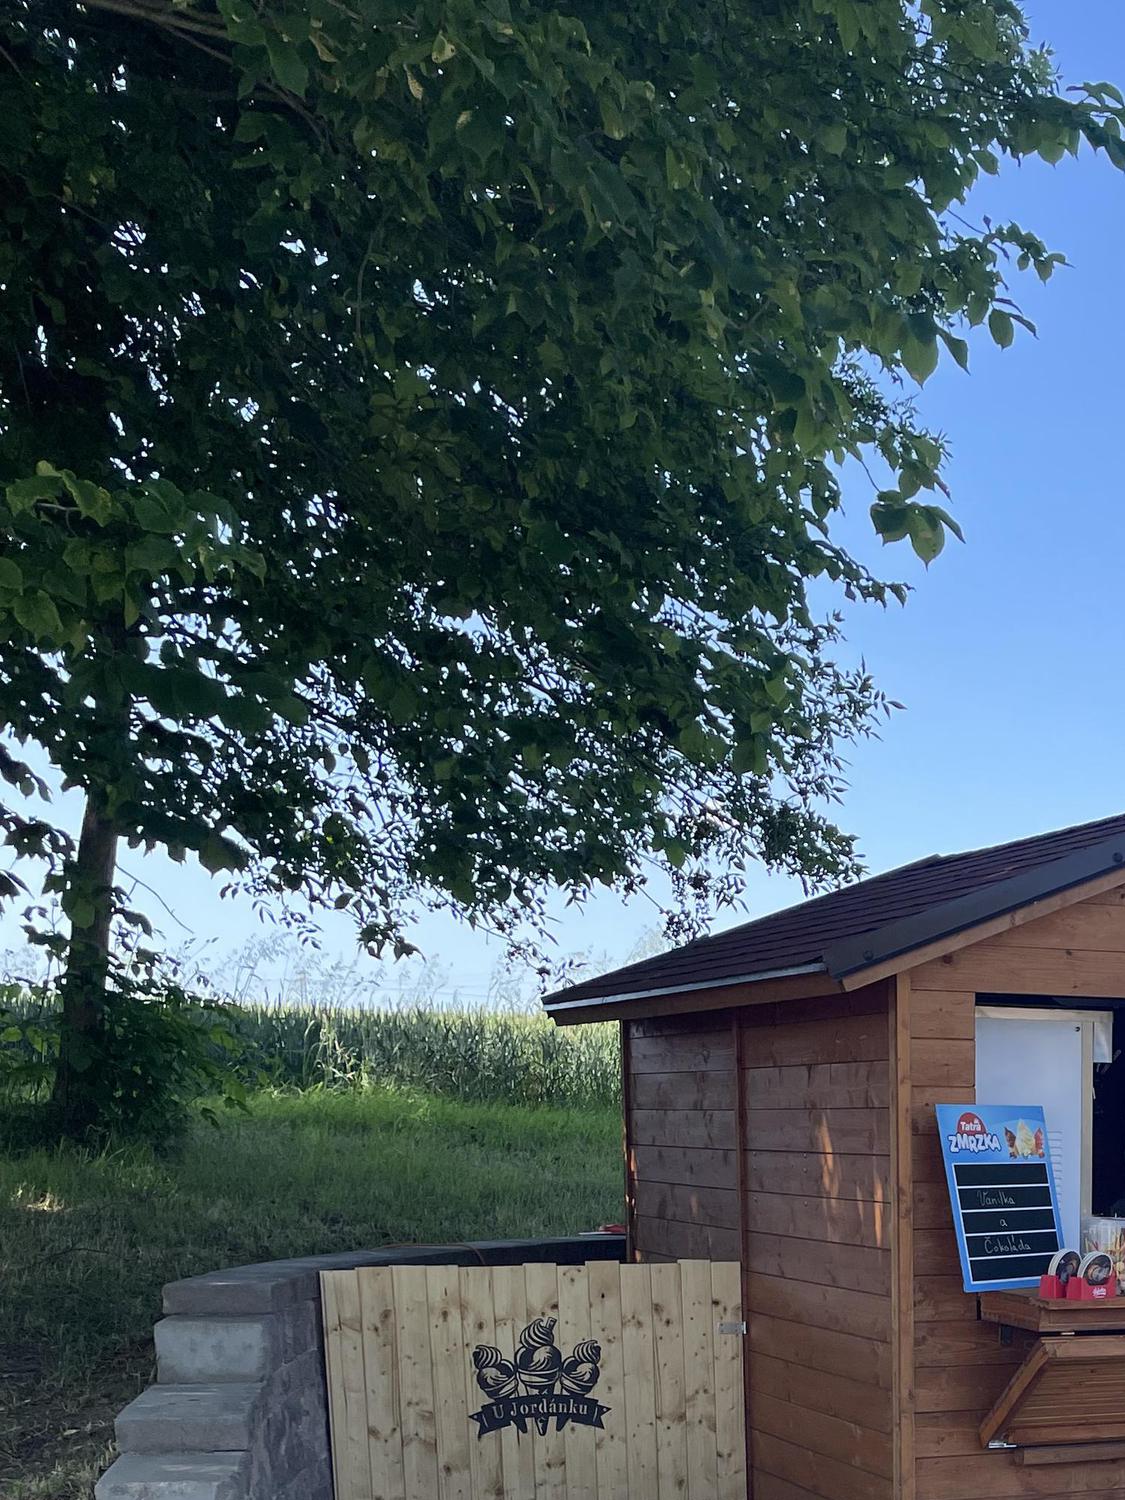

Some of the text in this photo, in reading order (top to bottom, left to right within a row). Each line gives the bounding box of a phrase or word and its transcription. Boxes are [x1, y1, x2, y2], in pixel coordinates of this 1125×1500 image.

[960, 1120, 981, 1132] Tatra
[948, 1133, 1002, 1153] ZMRZKA
[984, 1234, 1031, 1255] Čokoláda
[492, 1399, 588, 1419] U Jordánku
